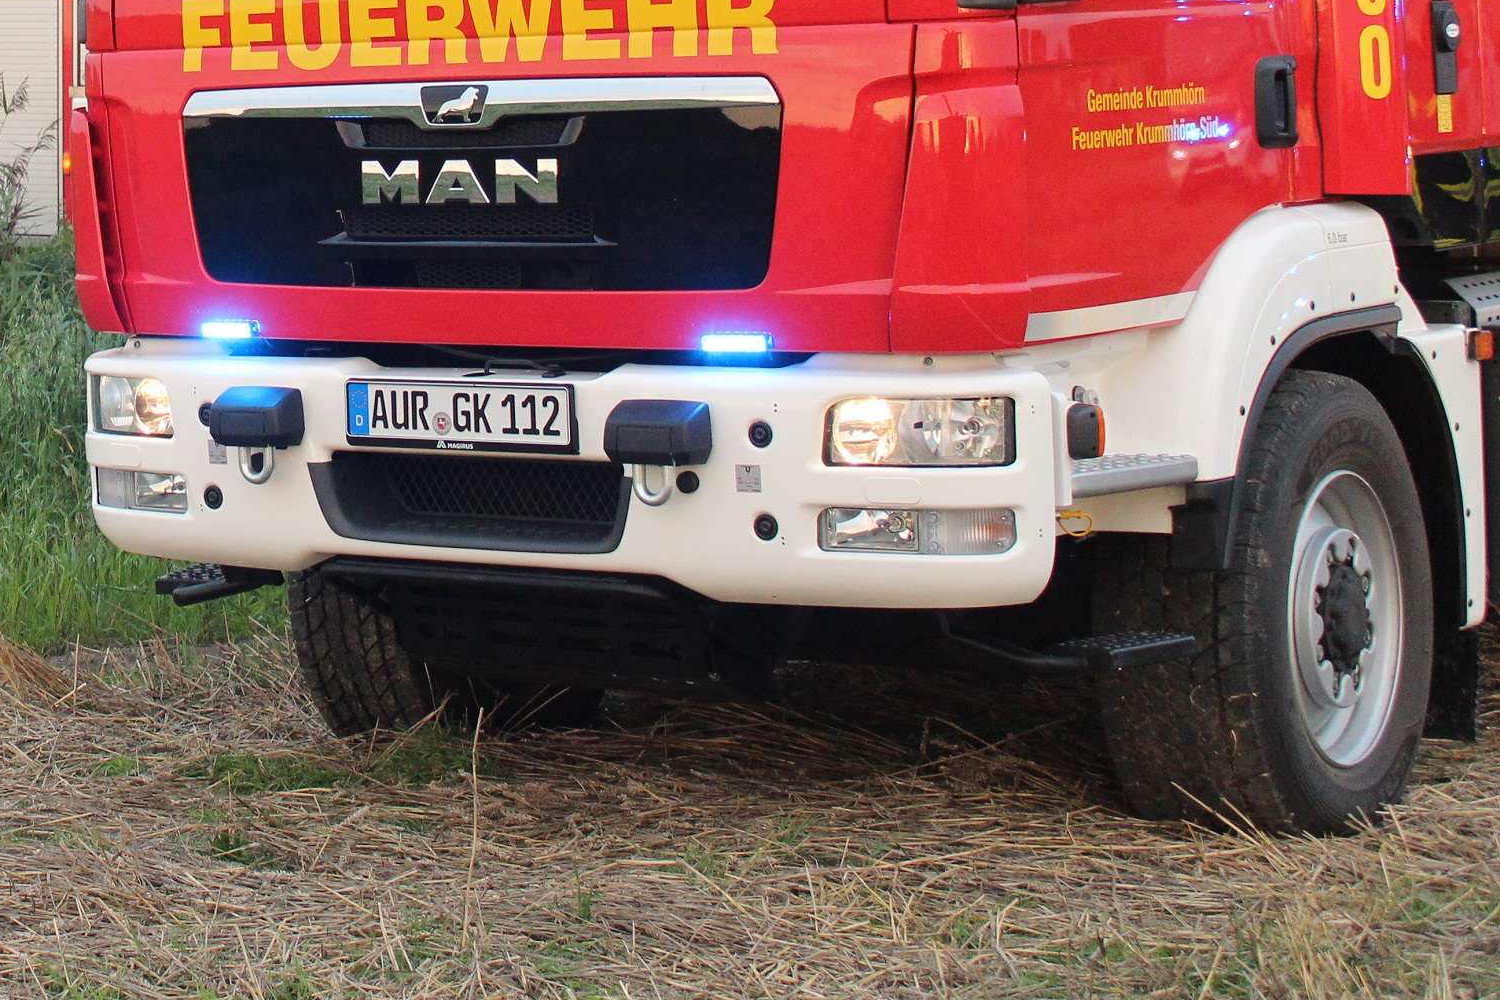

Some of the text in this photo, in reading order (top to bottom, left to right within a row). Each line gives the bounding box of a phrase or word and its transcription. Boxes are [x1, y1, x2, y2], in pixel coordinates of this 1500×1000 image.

[1087, 81, 1205, 112] Gemeinde Krummhörn
[1071, 124, 1134, 150] Feuerwehr
[361, 158, 558, 204] MAN
[355, 414, 364, 427] D
[371, 389, 561, 436] AUR GK 112
[447, 442, 474, 450] MAGIRUS
